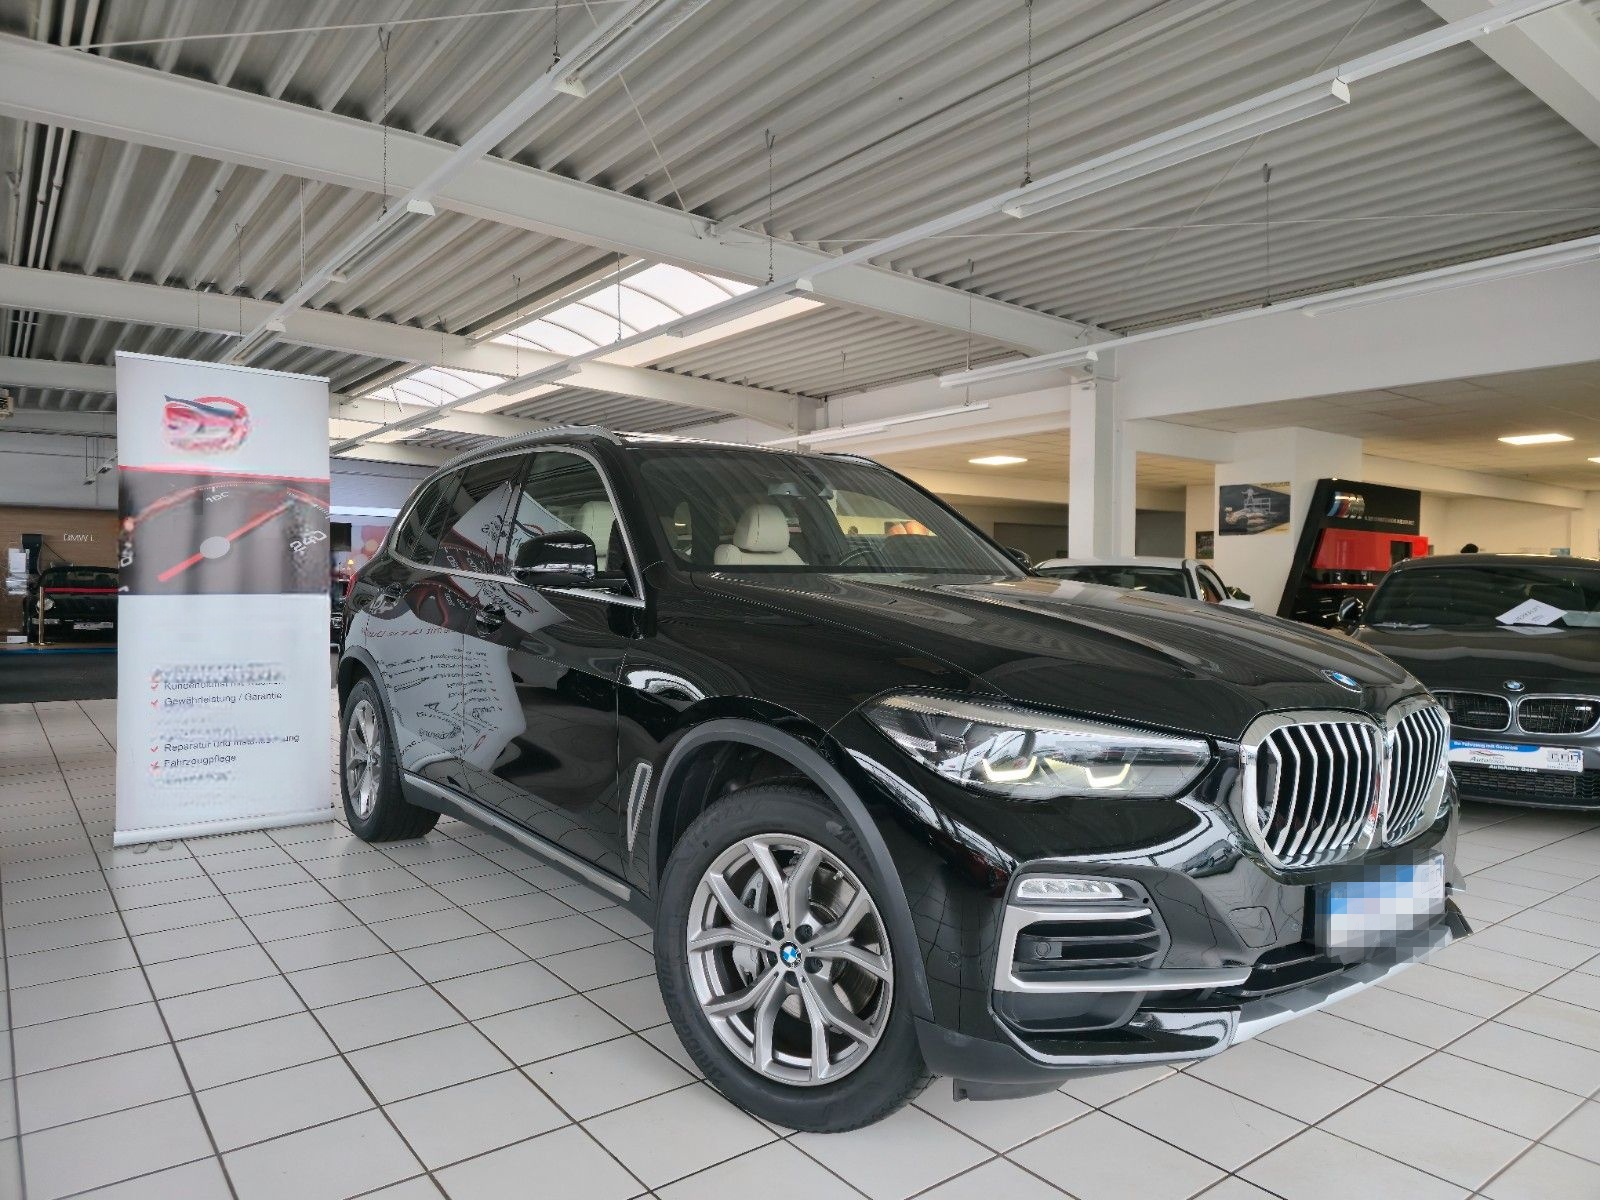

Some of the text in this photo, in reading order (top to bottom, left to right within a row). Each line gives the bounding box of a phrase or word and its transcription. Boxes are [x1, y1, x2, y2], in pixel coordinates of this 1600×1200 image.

[289, 529, 328, 552] 240
[164, 693, 236, 707] Gewährleistung
[244, 691, 283, 701] Garantie
[164, 741, 211, 753] Reparatur
[164, 754, 236, 768] Fahrzeugpflege
